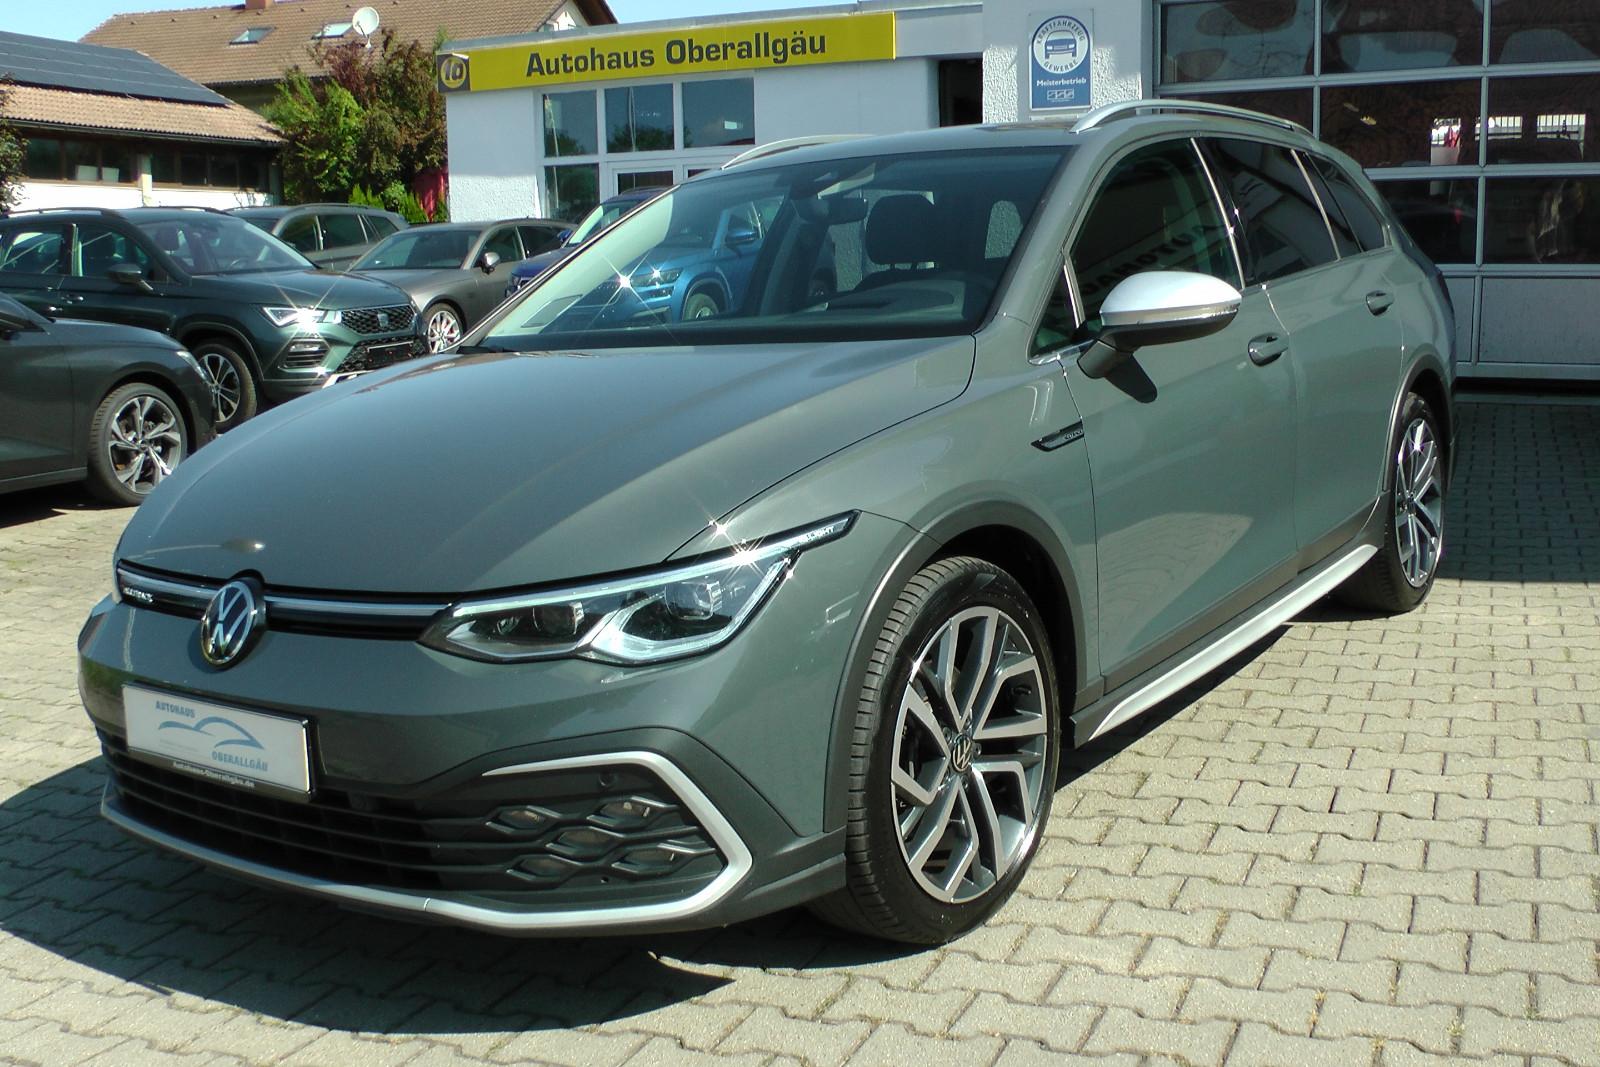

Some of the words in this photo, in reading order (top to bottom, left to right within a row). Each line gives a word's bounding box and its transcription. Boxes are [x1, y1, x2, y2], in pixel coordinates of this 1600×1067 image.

[526, 48, 655, 78] Autohaus
[665, 31, 826, 65] Oberallgäu
[1044, 60, 1079, 71] GEWERBE
[1037, 78, 1087, 87] Meisterbetrieb
[155, 700, 196, 718] AUTOHAUS
[211, 750, 269, 772] OBERALLGÄU
